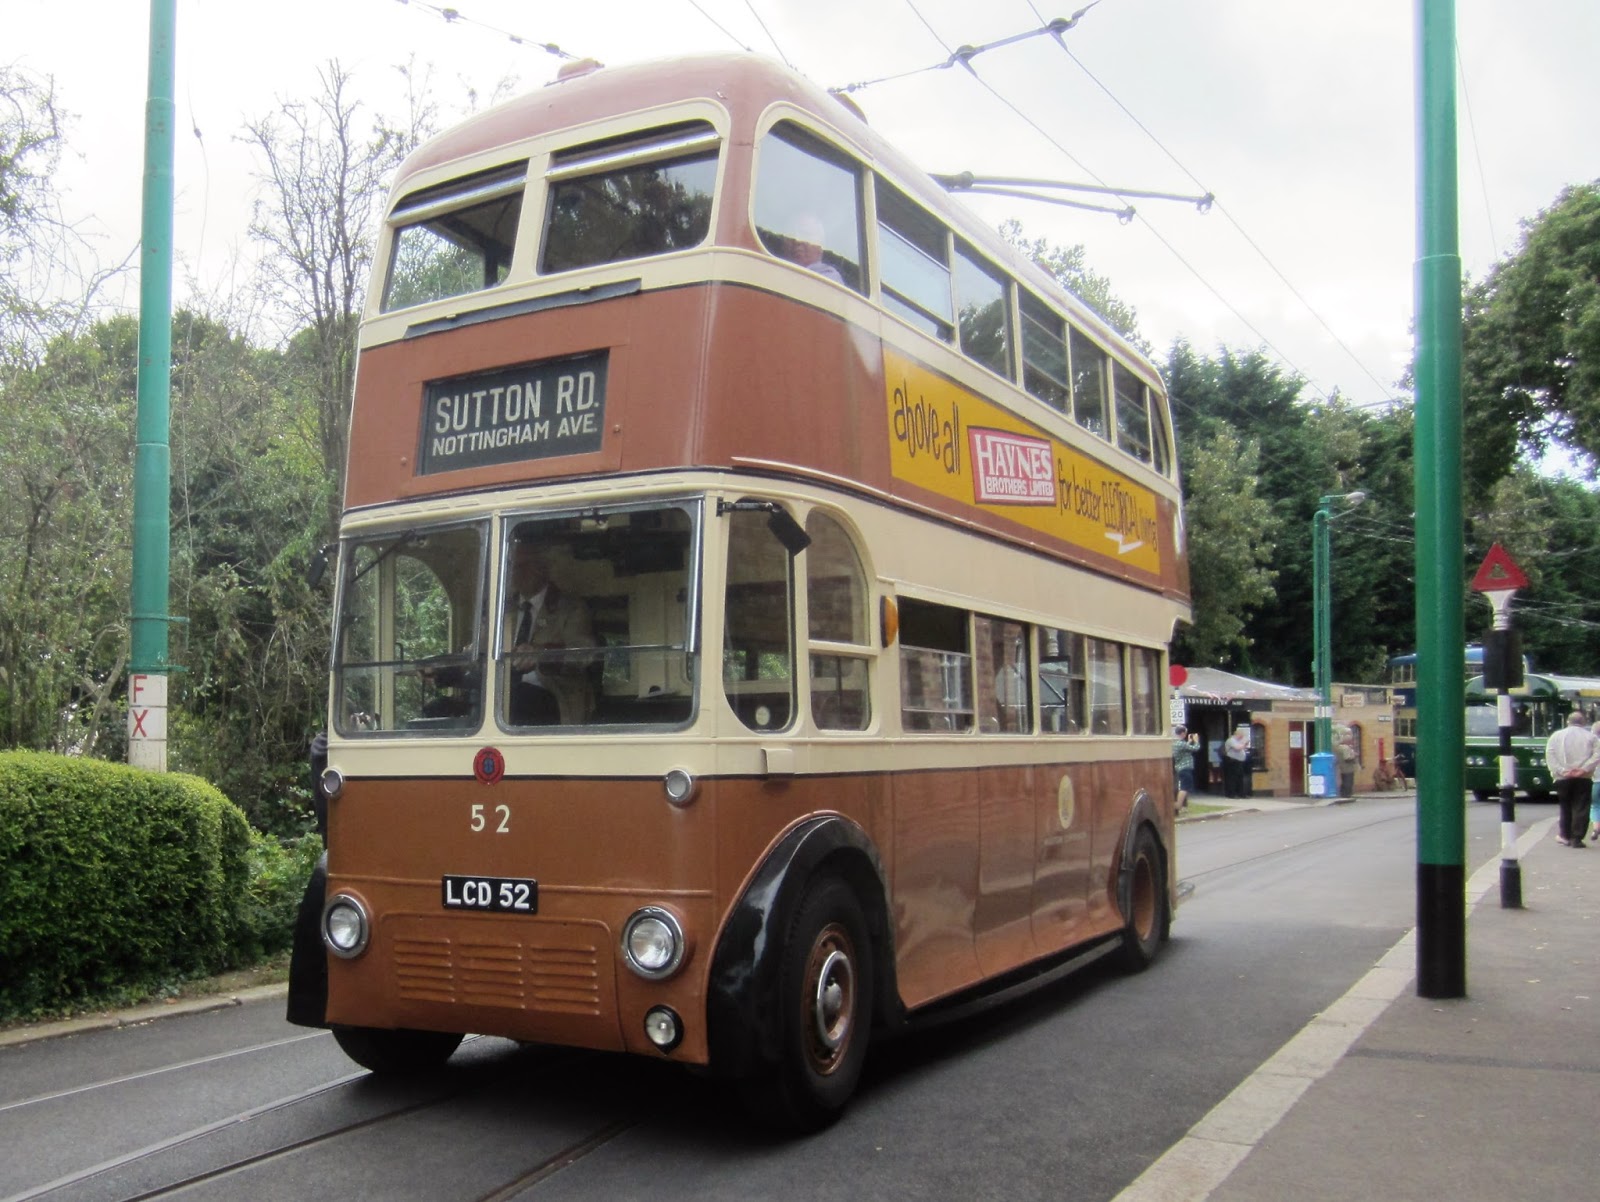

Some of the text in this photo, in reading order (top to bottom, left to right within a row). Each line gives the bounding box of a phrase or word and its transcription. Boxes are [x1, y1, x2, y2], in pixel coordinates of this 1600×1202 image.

[435, 371, 600, 434] SUTTON RD.
[432, 413, 598, 456] NOTTINGHAM AVE.
[893, 377, 961, 476] above all
[975, 434, 1054, 481] HAYNES
[985, 475, 1054, 497] BROTHERS LIMITED
[1057, 457, 1072, 517] for
[1072, 463, 1101, 522] better
[133, 673, 148, 703] F
[131, 709, 149, 738] X
[470, 804, 511, 833] 52
[446, 879, 530, 909] LCD 52
